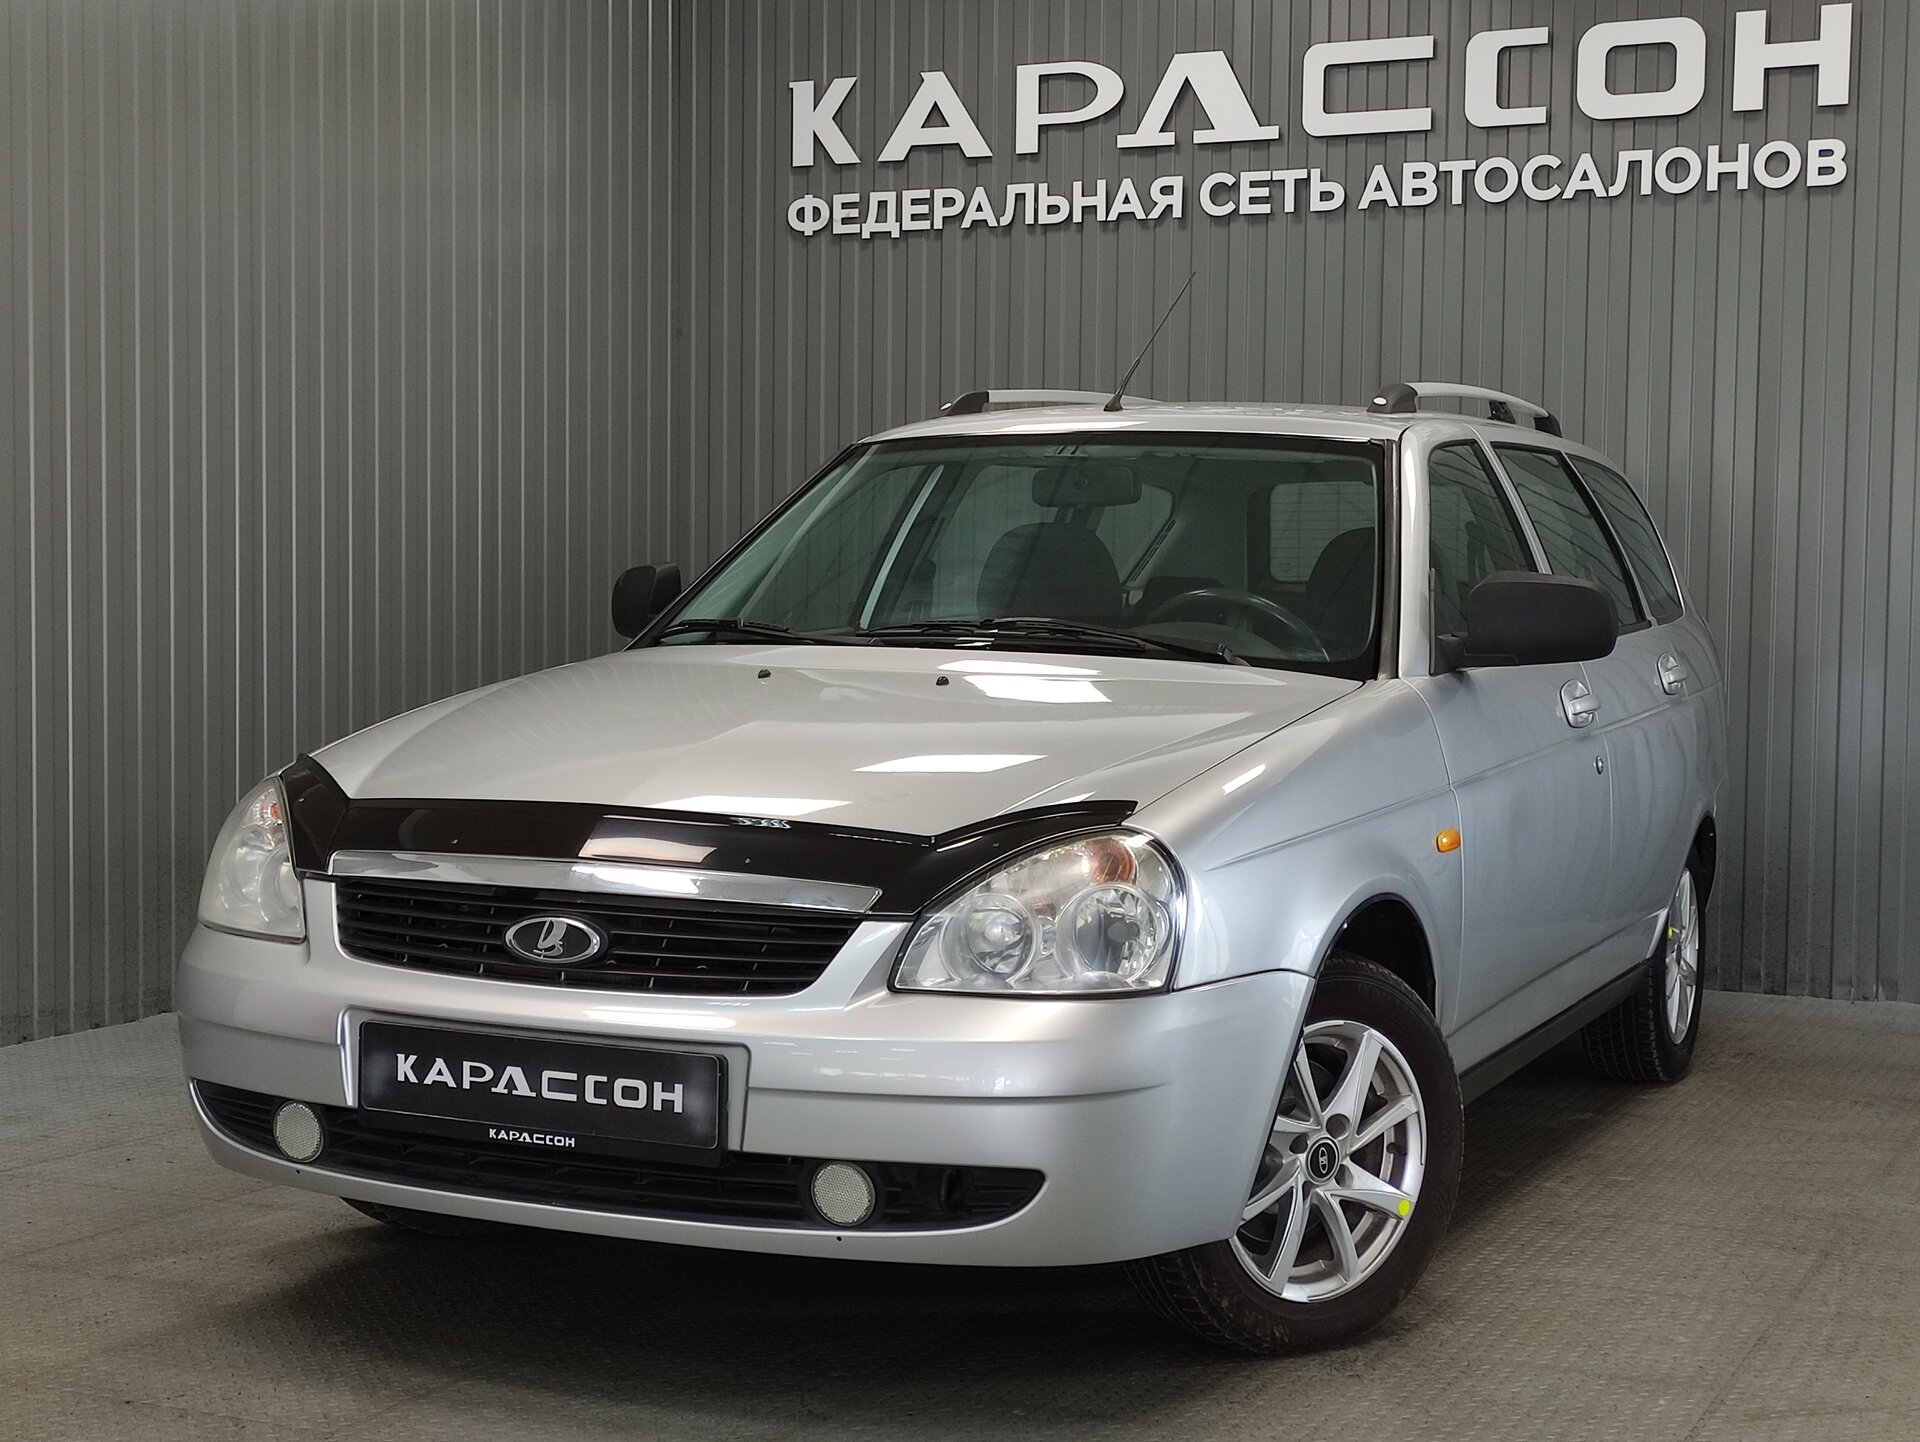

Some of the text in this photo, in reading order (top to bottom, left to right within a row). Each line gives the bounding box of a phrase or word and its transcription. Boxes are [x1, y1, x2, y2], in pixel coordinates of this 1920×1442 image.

[786, 137, 1849, 240] ФЕДЕРАЛЬНАЯ СЕТЬ АВТОСАЛОНОВ
